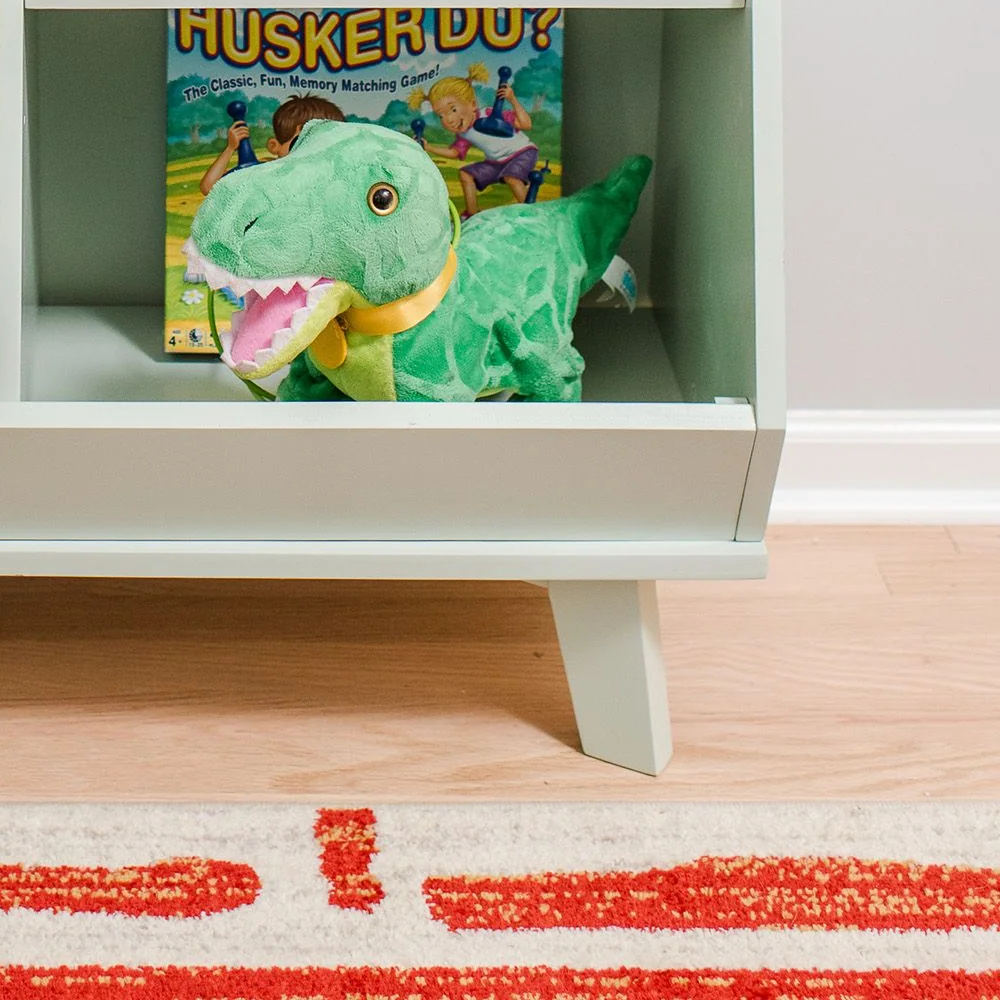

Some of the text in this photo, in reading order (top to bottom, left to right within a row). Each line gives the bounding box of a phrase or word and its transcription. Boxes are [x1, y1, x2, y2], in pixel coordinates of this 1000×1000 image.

[176, 8, 426, 71] HUSKER
[183, 64, 440, 102] The Classic, Fun, Memory Matching Game!
